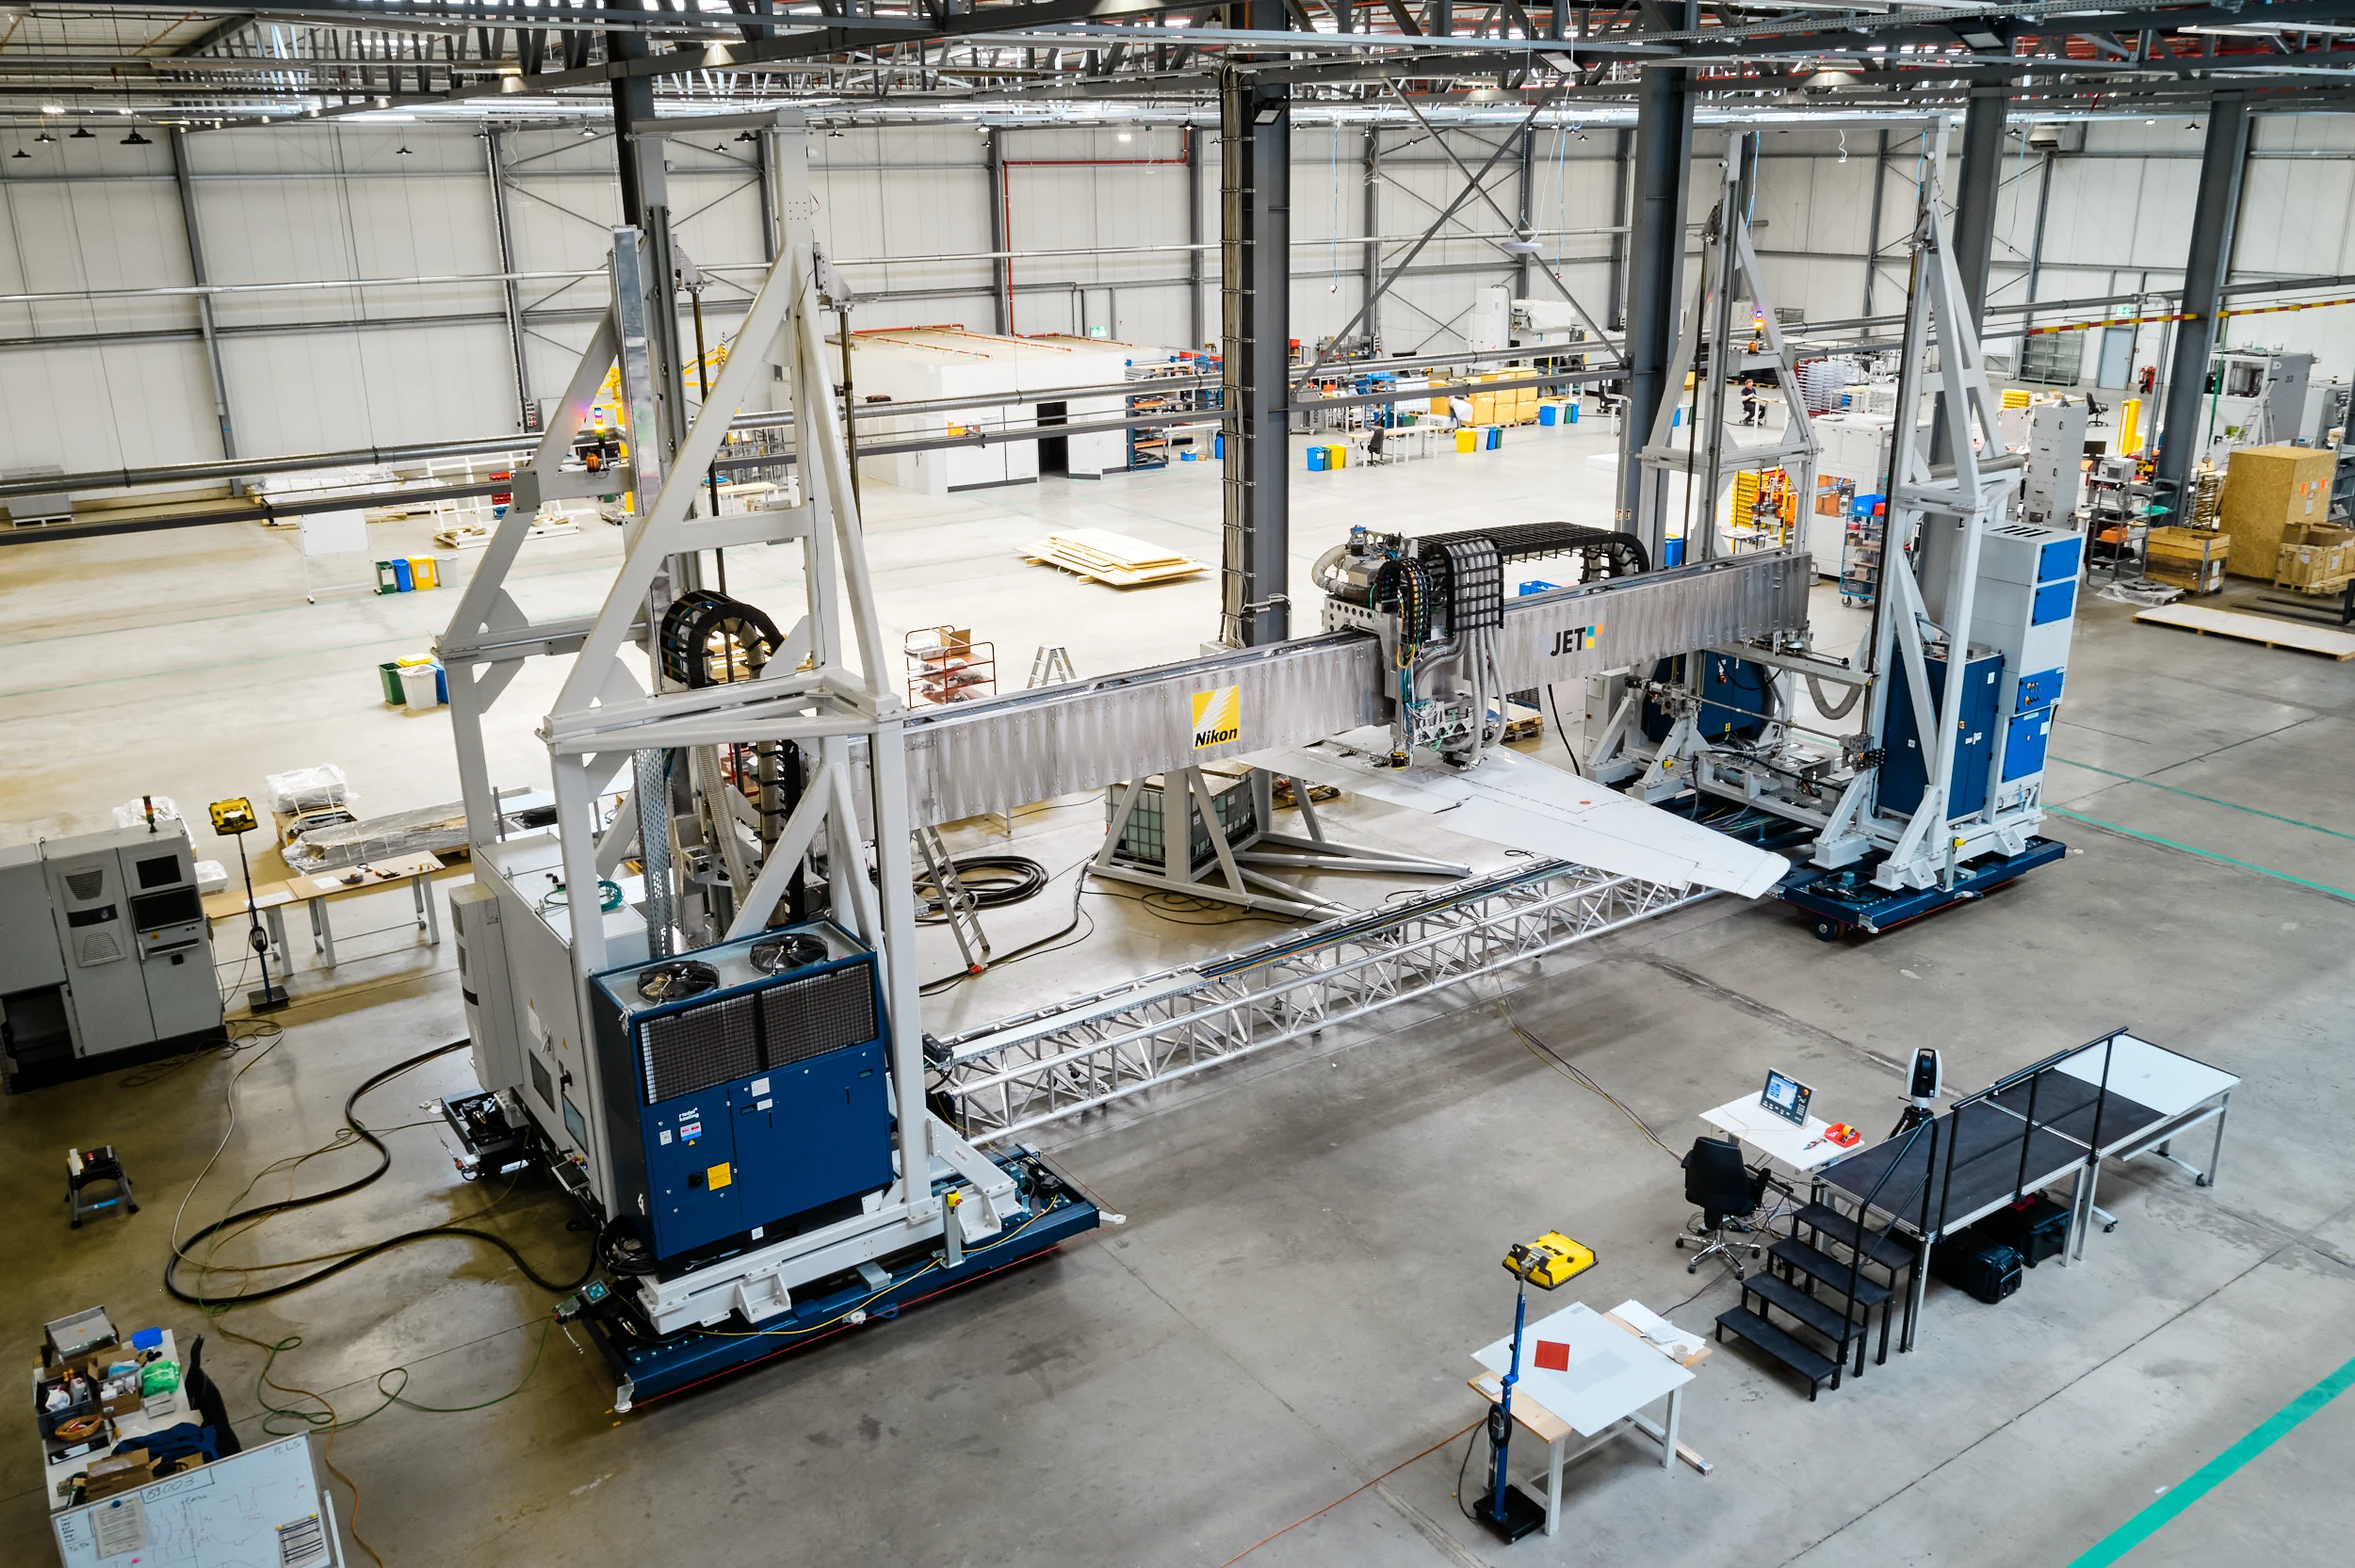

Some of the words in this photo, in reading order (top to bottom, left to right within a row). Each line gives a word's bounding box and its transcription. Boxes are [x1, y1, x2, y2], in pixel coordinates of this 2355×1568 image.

[1551, 626, 1585, 657] JET
[1194, 728, 1238, 748] Nikon
[146, 1476, 195, 1500] 89003
